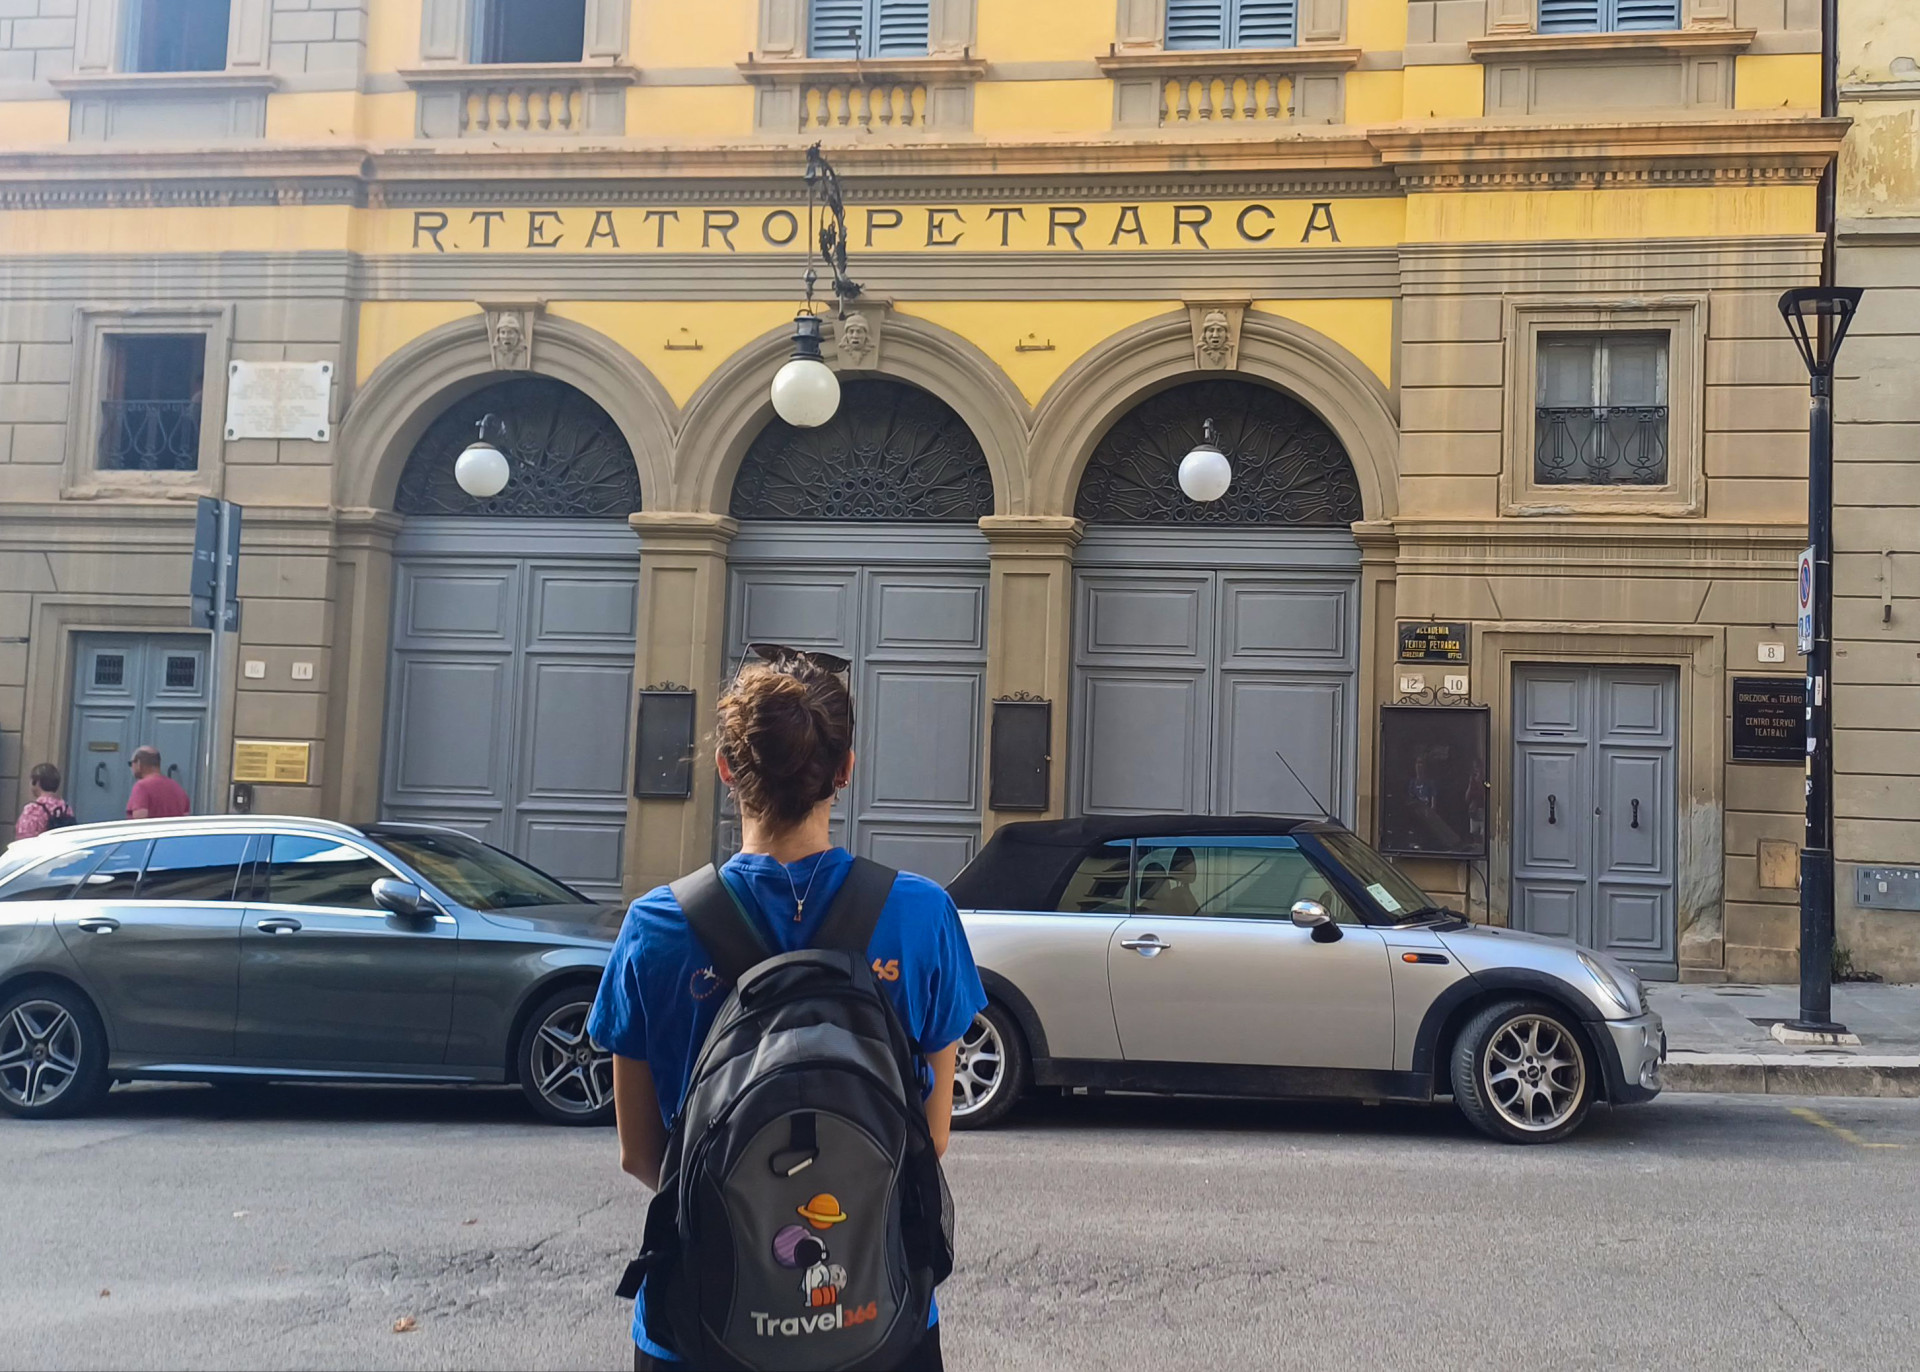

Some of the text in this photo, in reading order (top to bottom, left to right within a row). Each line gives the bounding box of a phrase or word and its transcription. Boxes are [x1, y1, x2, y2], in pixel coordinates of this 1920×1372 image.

[864, 202, 1342, 251] PETRARCA
[1404, 640, 1460, 650] TEATRO PETRARCA
[1767, 646, 1776, 659] 8
[1406, 678, 1418, 690] 12
[1450, 680, 1462, 690] 10
[1738, 694, 1770, 702] DIREZIONE
[1780, 694, 1803, 704] TEATRO
[1746, 718, 1796, 727] CENTRO SERVIZI
[1754, 728, 1788, 738] TEATRALI
